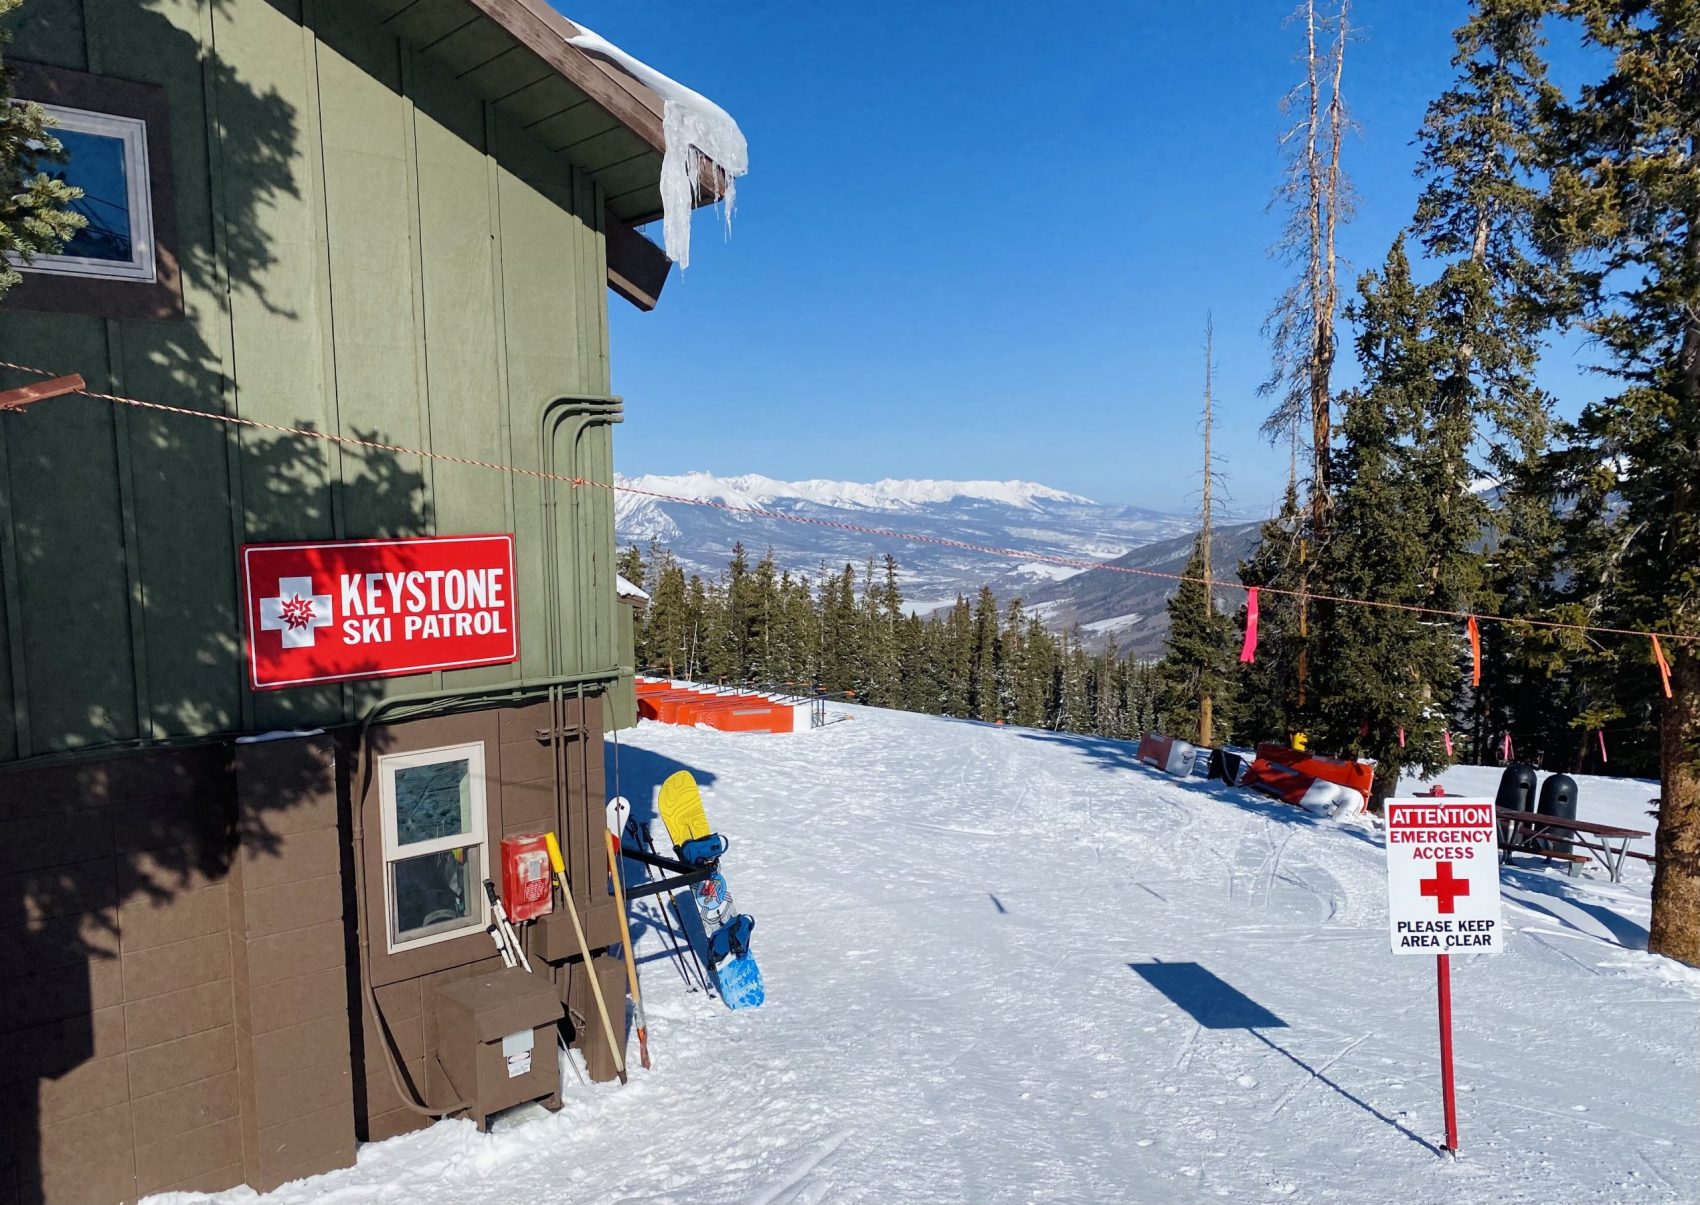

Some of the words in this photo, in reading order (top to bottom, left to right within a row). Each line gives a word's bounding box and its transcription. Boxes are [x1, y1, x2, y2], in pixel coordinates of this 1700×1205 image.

[340, 568, 505, 616] KEYSTONE
[342, 617, 392, 645] SKI
[404, 611, 507, 641] PATROL
[1392, 808, 1491, 825] ATTENTION
[1390, 830, 1493, 843] EMERGENCY
[1413, 847, 1474, 859] ACCESS
[1397, 921, 1452, 933] PLEASE
[1458, 920, 1495, 932] KEEP
[1400, 935, 1440, 947] AREA
[1445, 934, 1492, 947] CLEAR
